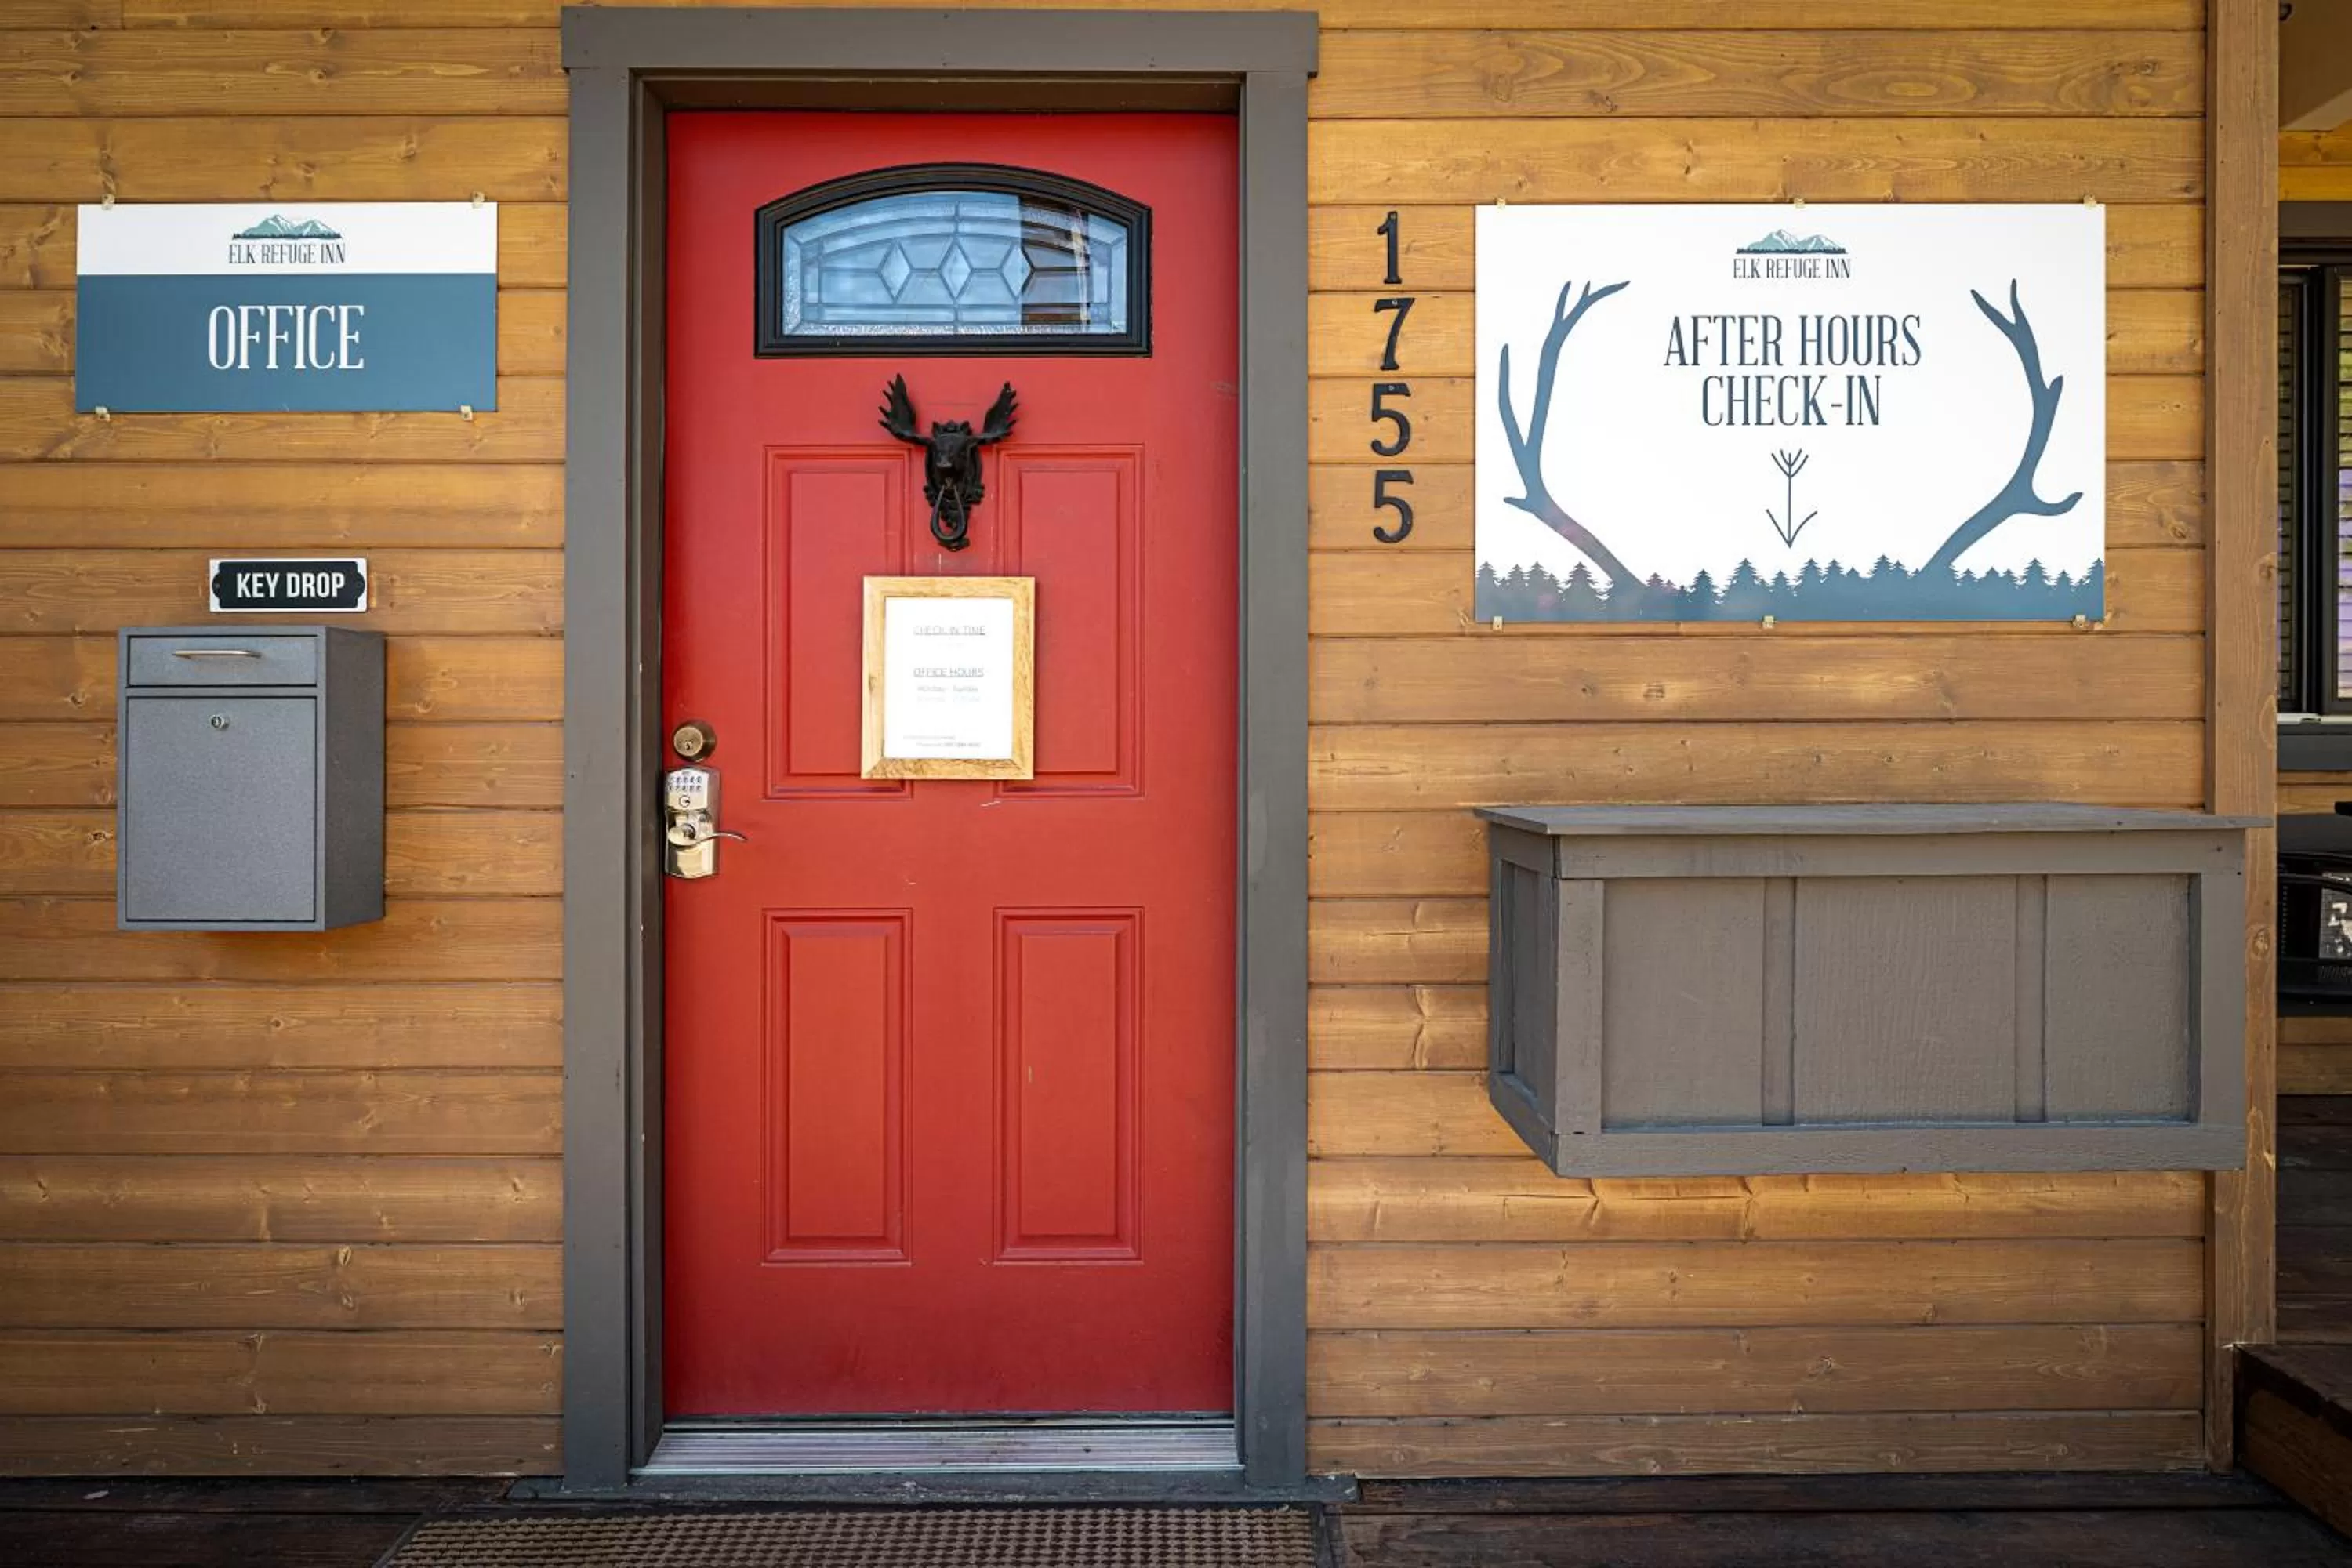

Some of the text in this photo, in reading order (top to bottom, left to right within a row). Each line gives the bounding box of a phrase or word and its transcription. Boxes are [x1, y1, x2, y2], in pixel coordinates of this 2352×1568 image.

[228, 243, 346, 264] ELK REFUGE INN
[1733, 257, 1851, 279] ELK REFUGE INN
[208, 304, 365, 371] OFFICE
[1663, 314, 1922, 367] AFTER HOURS
[1701, 374, 1882, 427] CHECK-IN
[236, 571, 346, 599] KEY DROP
